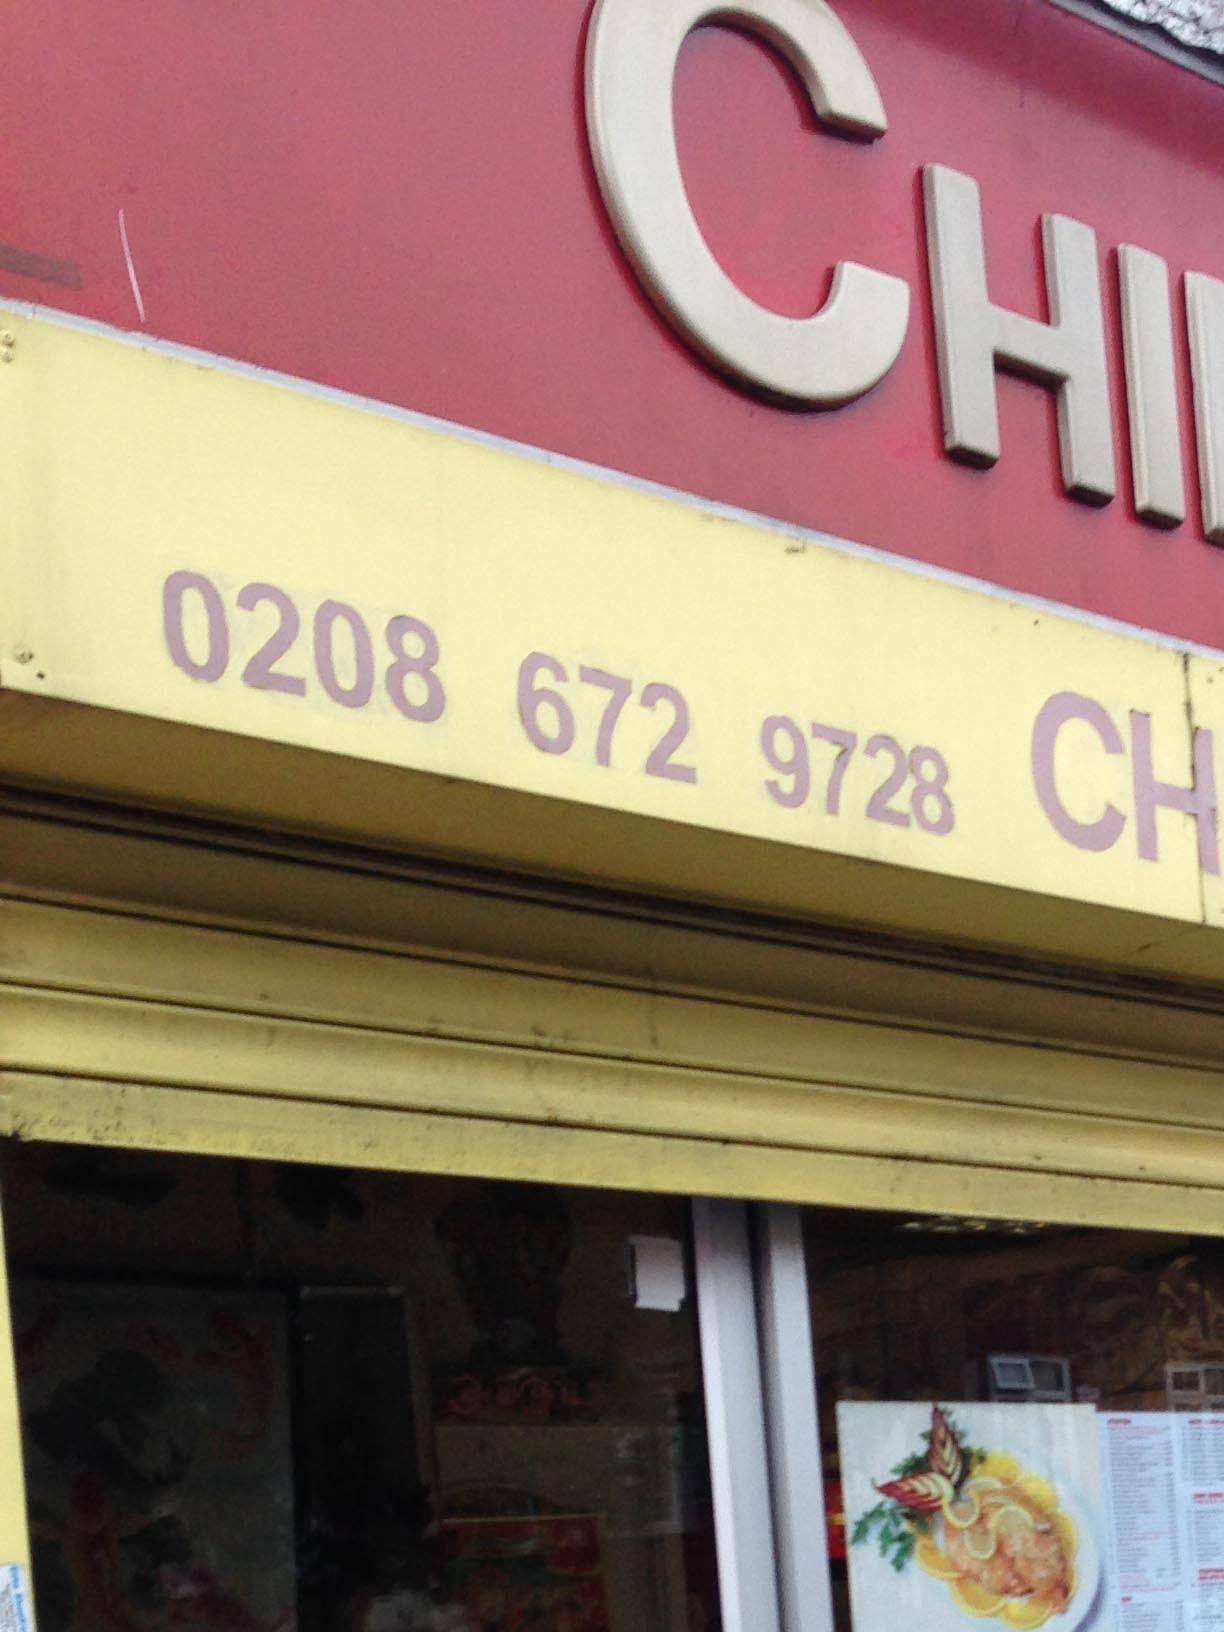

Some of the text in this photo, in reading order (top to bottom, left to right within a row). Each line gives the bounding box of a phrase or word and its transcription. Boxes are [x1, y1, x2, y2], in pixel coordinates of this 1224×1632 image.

[161, 569, 955, 837] 0208 672 9728
